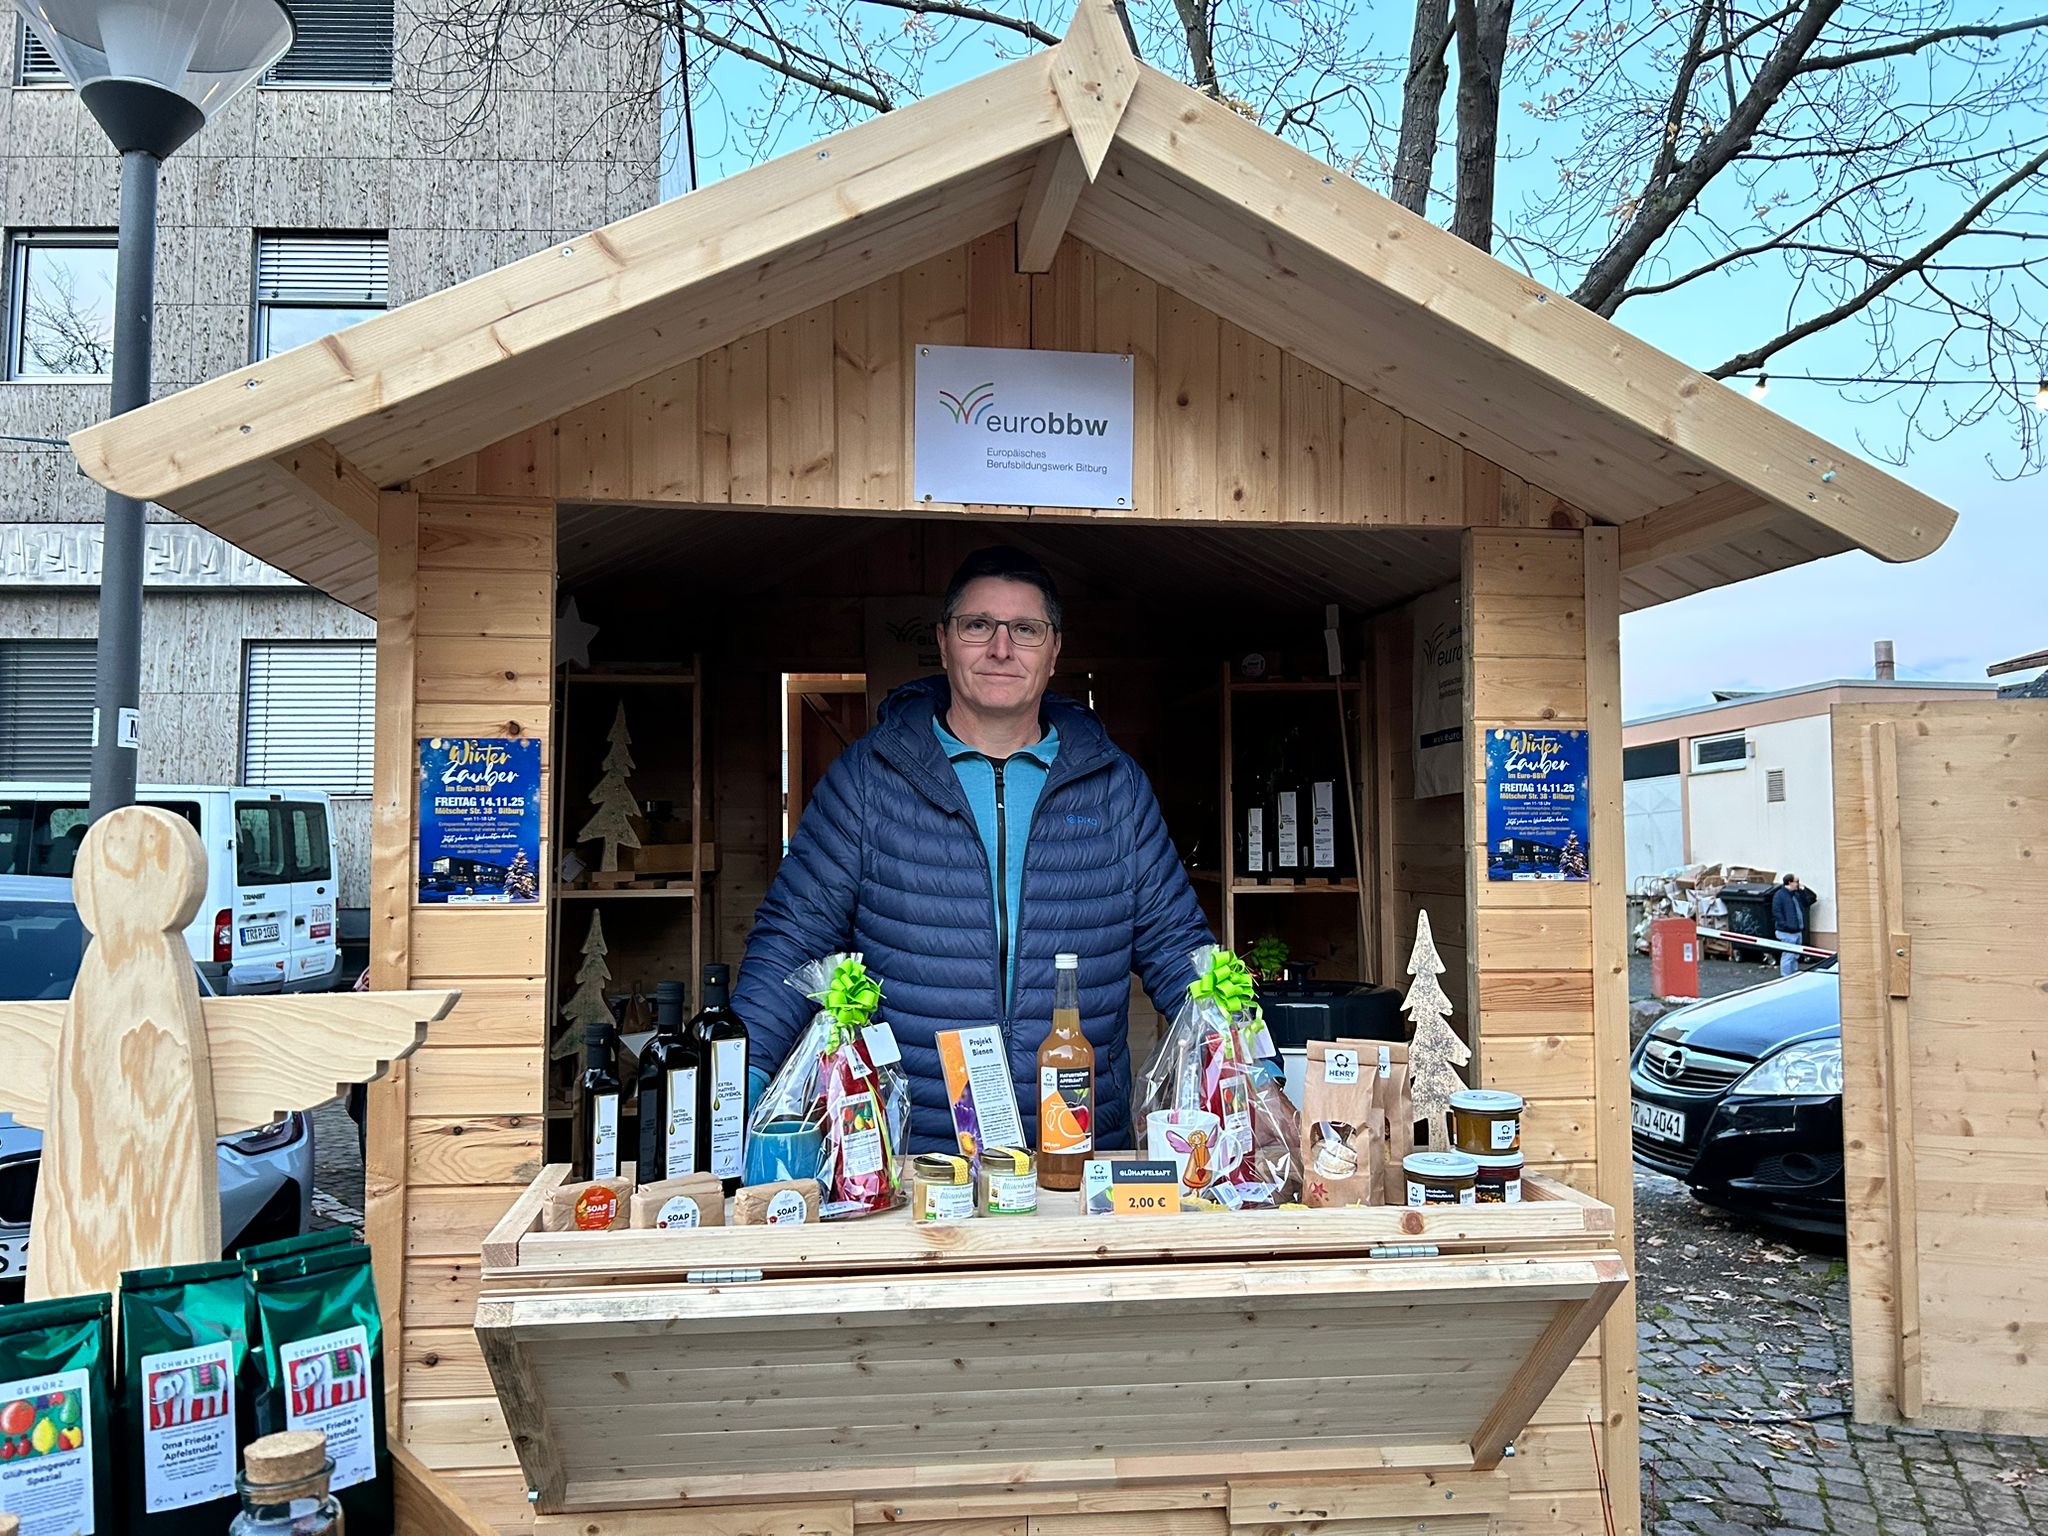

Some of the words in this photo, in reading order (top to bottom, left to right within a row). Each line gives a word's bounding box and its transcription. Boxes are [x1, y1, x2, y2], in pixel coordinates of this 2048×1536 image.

[986, 412, 1109, 437] eurobbw
[987, 447, 1047, 459] Europäisches
[986, 459, 1074, 472] Berufsbildungswerk
[1076, 462, 1108, 475] Bitburg
[1437, 645, 1463, 666] euro
[1510, 731, 1563, 755] Winter
[449, 740, 512, 768] Winter
[1504, 749, 1570, 774] Zauber
[440, 760, 520, 787] Zauber
[1499, 783, 1534, 792] FREITAG
[1537, 783, 1575, 792] 14.11.25
[434, 796, 477, 807] FREITAG
[480, 796, 525, 807] 14.11.25
[969, 1037, 993, 1047] Projekt
[972, 1048, 994, 1056] Bienen
[1329, 1069, 1355, 1077] HENRY
[1653, 1110, 1681, 1137] 4041
[1119, 1168, 1171, 1177] GLÜHAPFELSAFT
[586, 1203, 608, 1213] SOAP
[1128, 1197, 1154, 1209] 2,00
[1157, 1197, 1166, 1208] €
[667, 1212, 690, 1222] SOAP
[777, 1205, 797, 1217] SOAP
[294, 1337, 355, 1358] SCHWARZTEE
[155, 1352, 219, 1370] SCHWARZTEE
[16, 1380, 64, 1395] GEWÜRZ
[326, 1426, 358, 1441] lstrudel
[162, 1441, 183, 1451] Oma
[164, 1442, 218, 1461] Apfelstrudel
[2, 1457, 81, 1480] Glühweingewürz
[26, 1471, 62, 1486] Spezial
